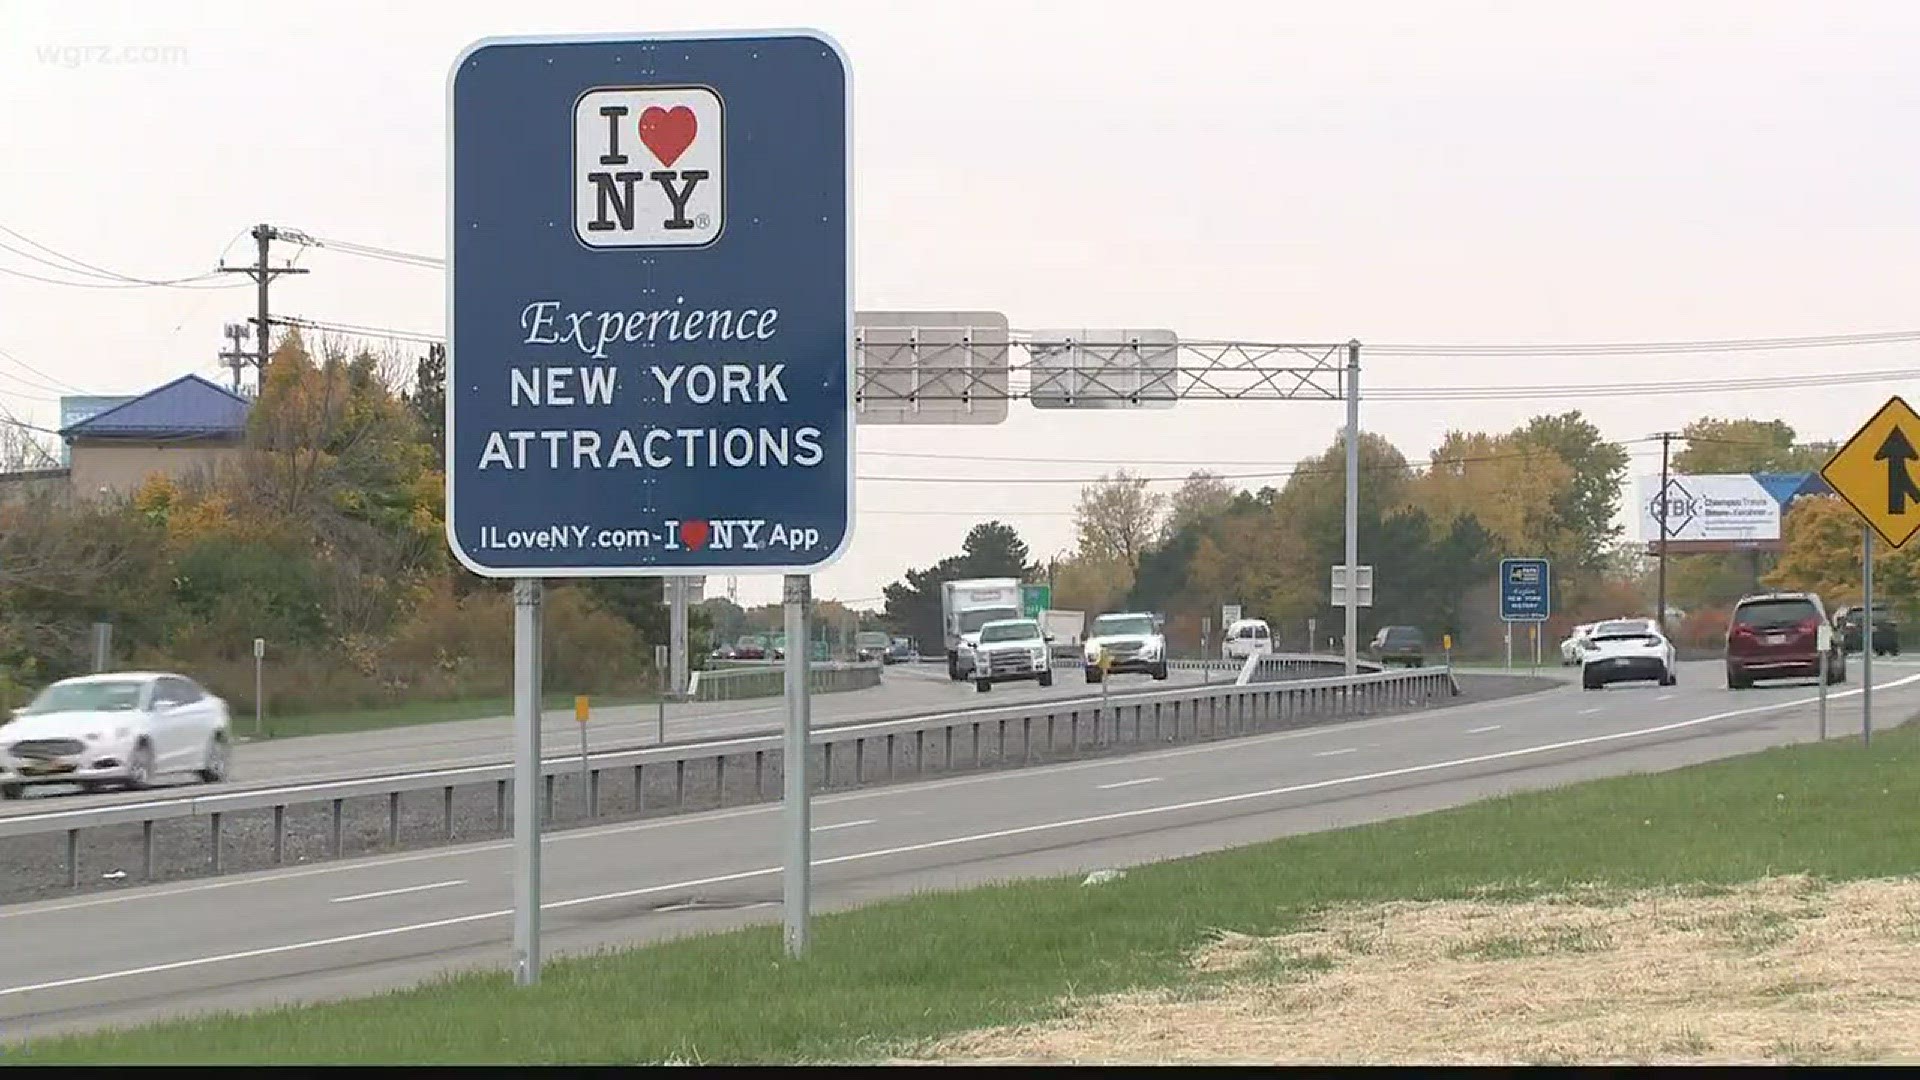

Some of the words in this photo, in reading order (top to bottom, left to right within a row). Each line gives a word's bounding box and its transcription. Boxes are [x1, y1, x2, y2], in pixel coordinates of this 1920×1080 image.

[600, 106, 629, 165] I
[521, 296, 778, 358] Experience
[510, 366, 617, 407] NEW
[650, 364, 788, 404] YORK
[478, 427, 823, 470] ATTRACTIONS
[768, 523, 819, 550] App
